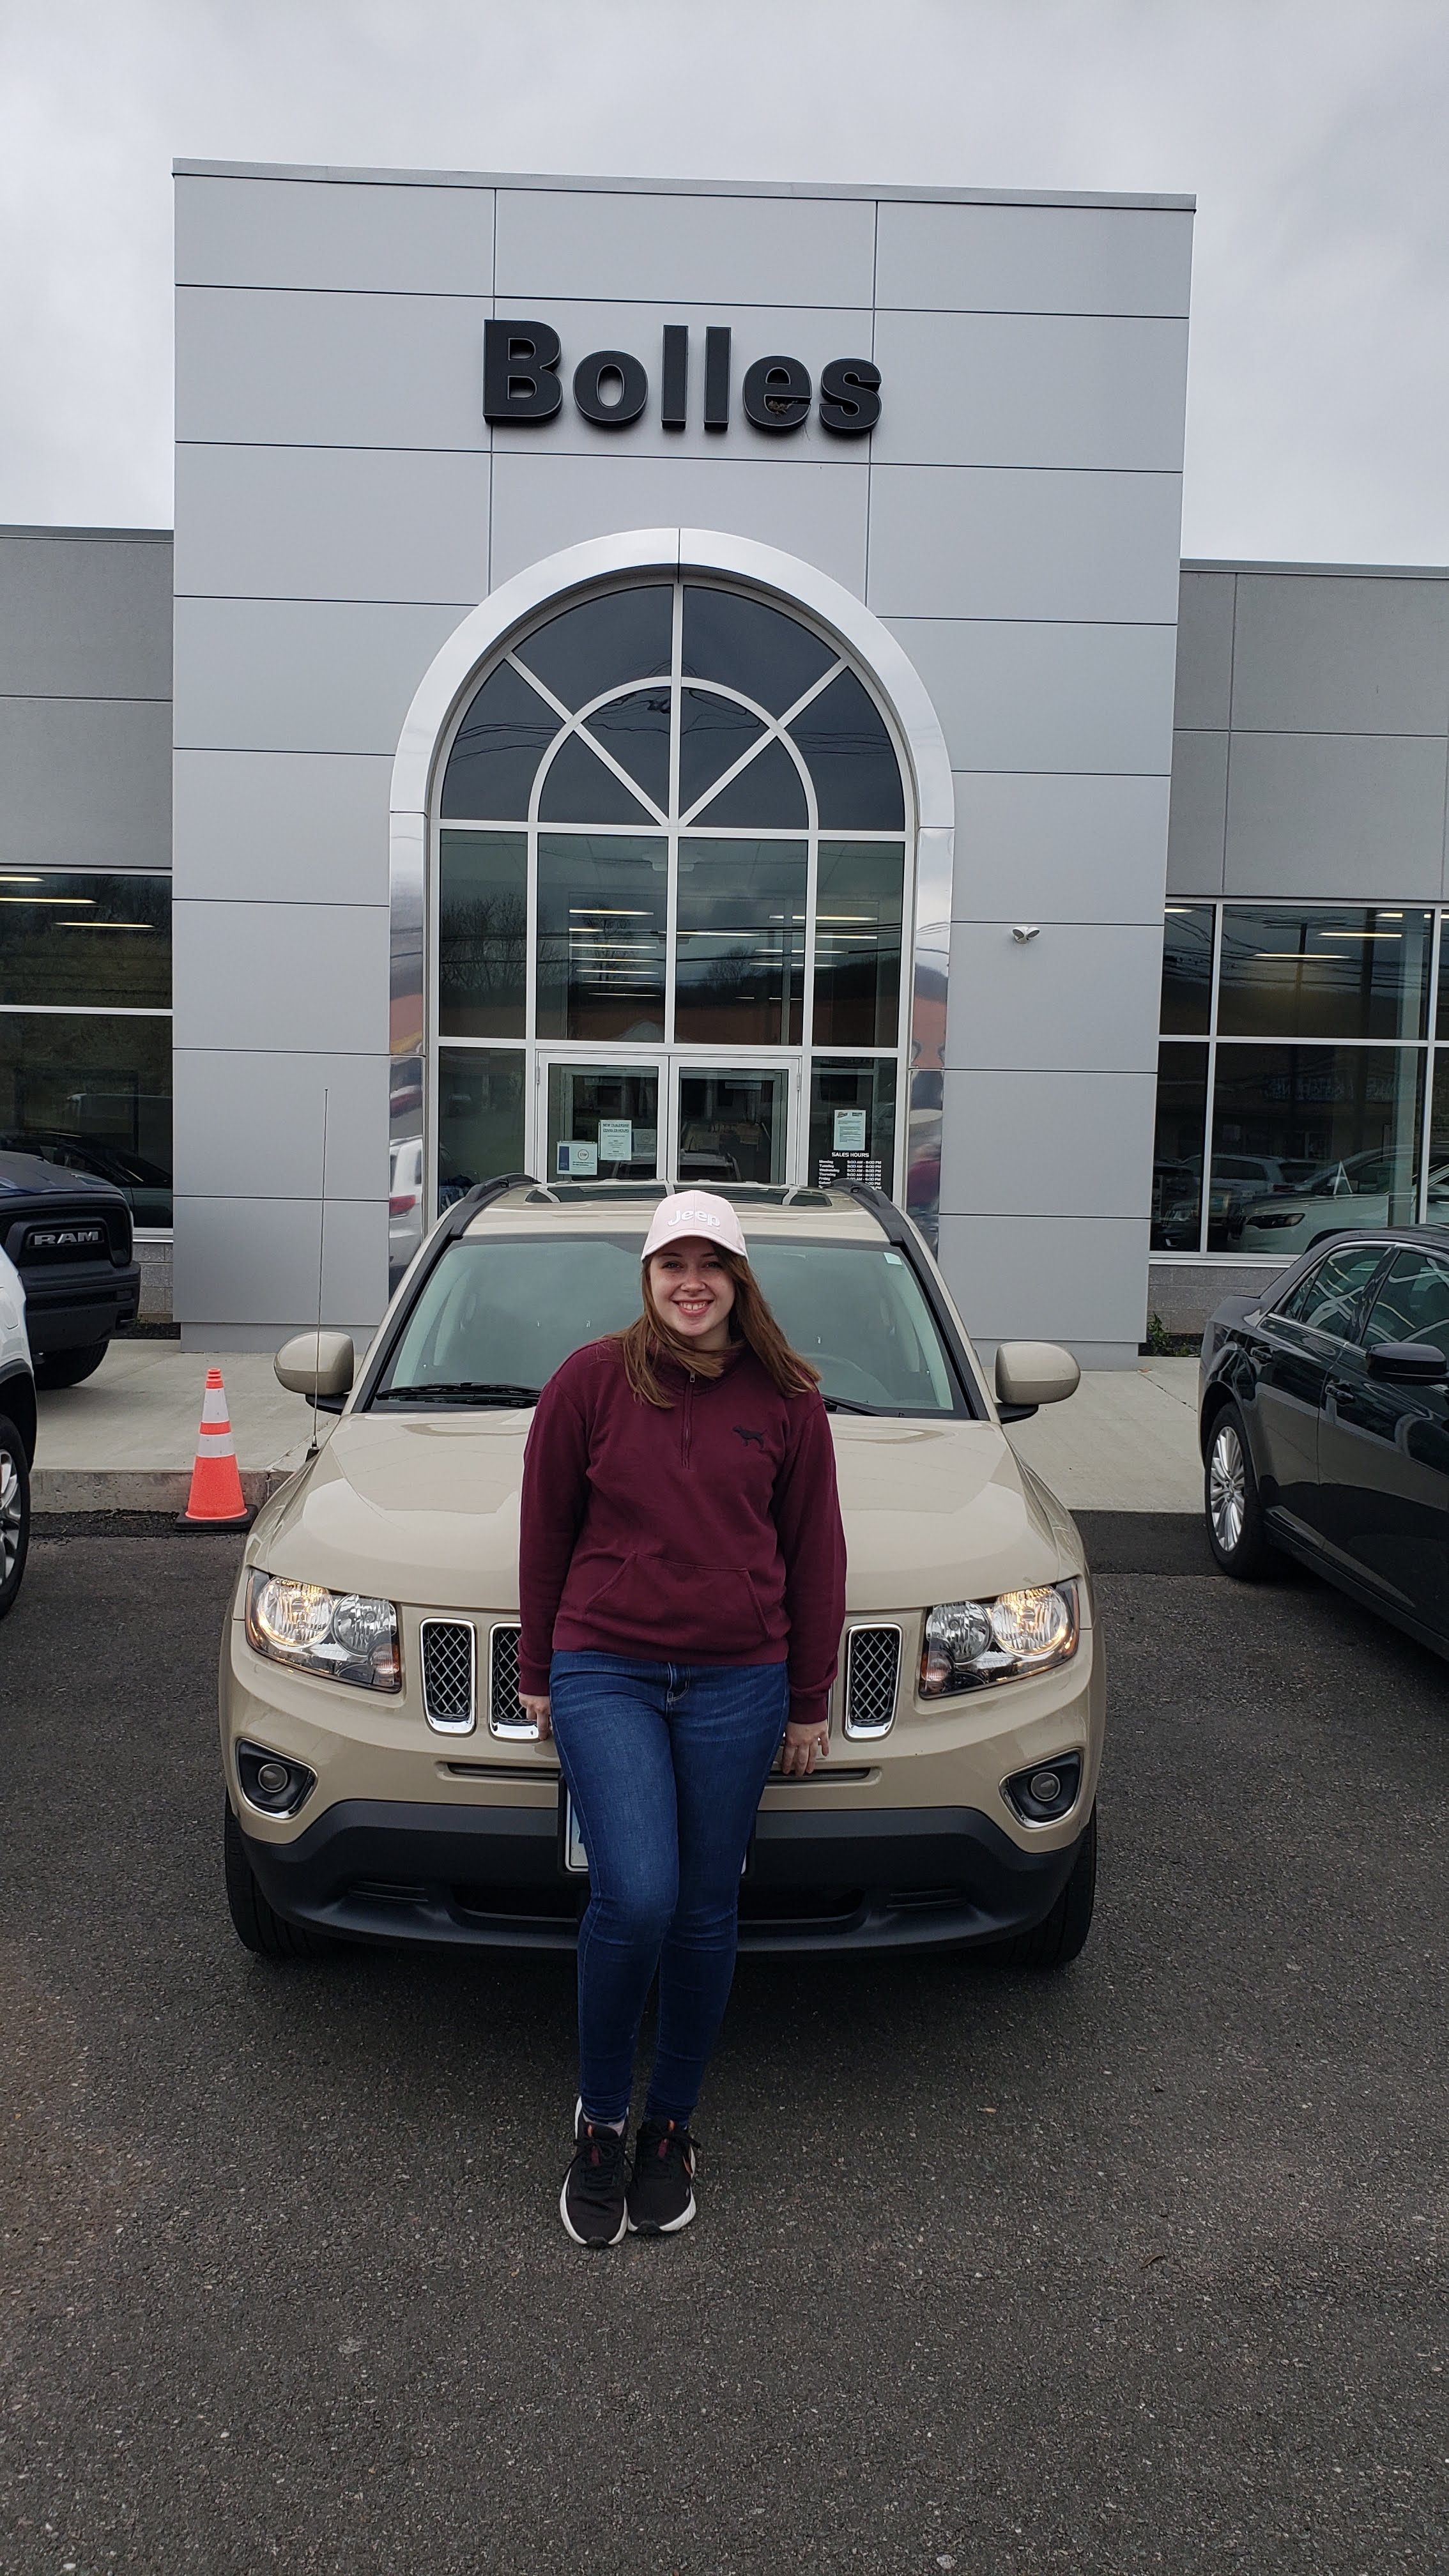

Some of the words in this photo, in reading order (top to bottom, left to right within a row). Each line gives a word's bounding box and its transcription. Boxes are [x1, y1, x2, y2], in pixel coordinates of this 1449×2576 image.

[484, 319, 882, 436] Bolles
[668, 1210, 721, 1227] Jeep
[34, 1231, 98, 1245] RAM
